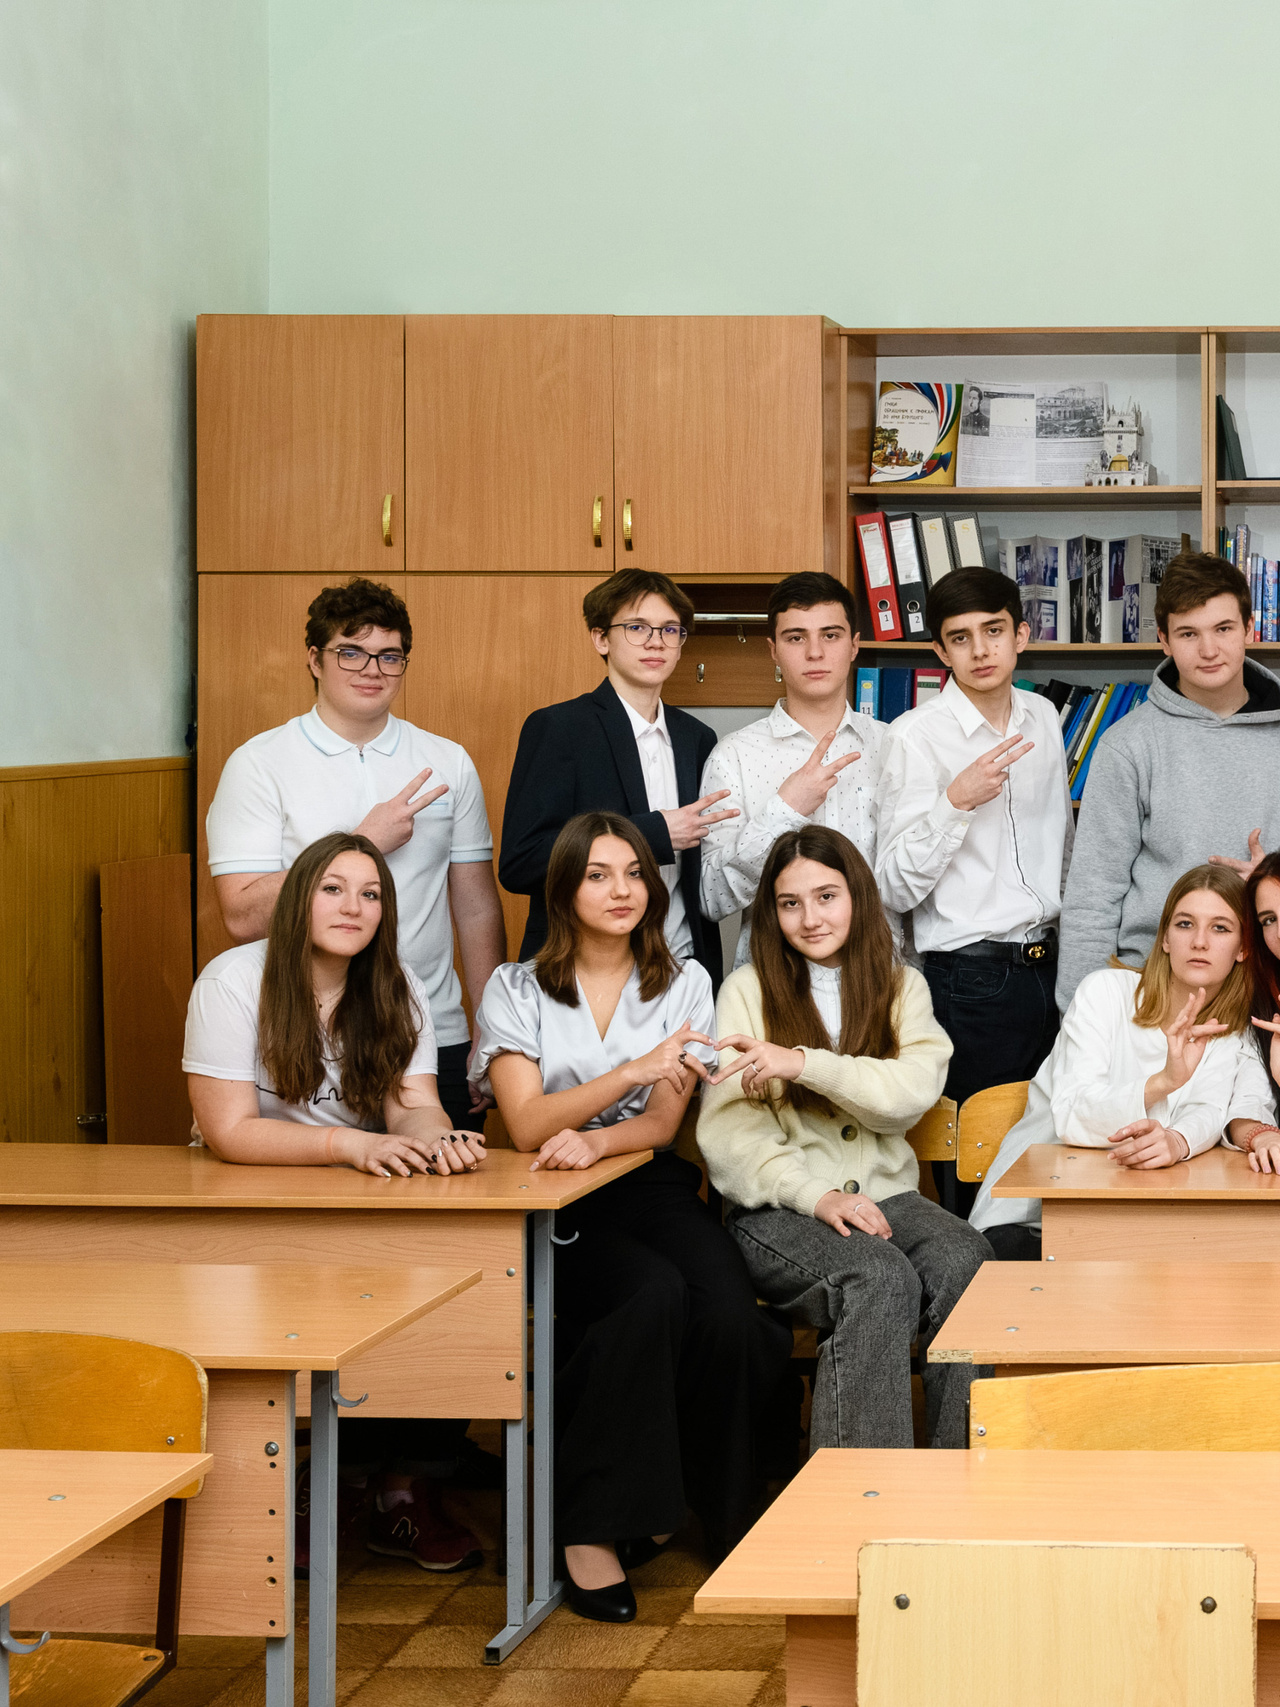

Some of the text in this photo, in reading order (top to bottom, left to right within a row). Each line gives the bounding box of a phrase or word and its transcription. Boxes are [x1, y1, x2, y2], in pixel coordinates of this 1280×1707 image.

[885, 614, 890, 622] 1
[914, 615, 921, 624] 2
[861, 706, 871, 715] 11
